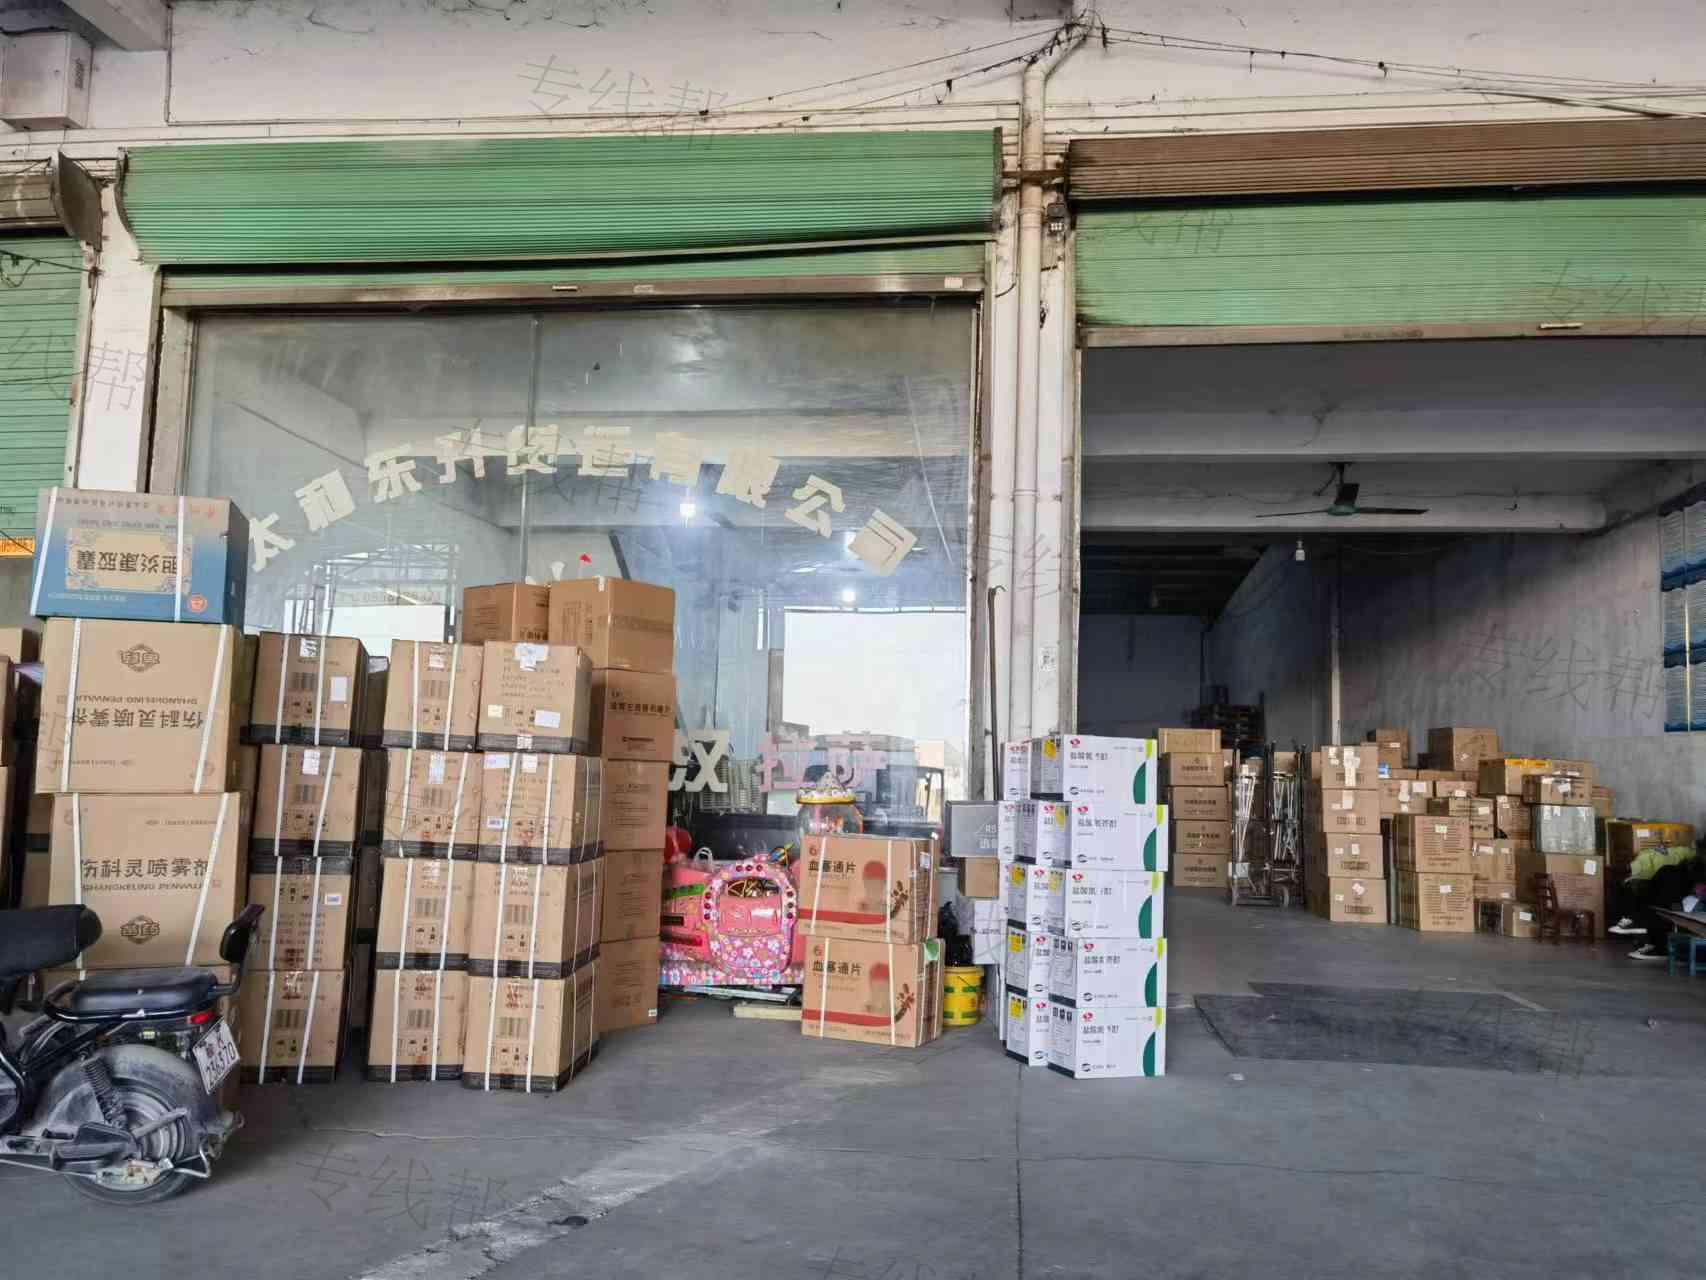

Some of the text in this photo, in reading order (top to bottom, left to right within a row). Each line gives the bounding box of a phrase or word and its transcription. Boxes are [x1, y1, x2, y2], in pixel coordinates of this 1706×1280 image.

[76, 550, 178, 575] 胆炎康胶囊
